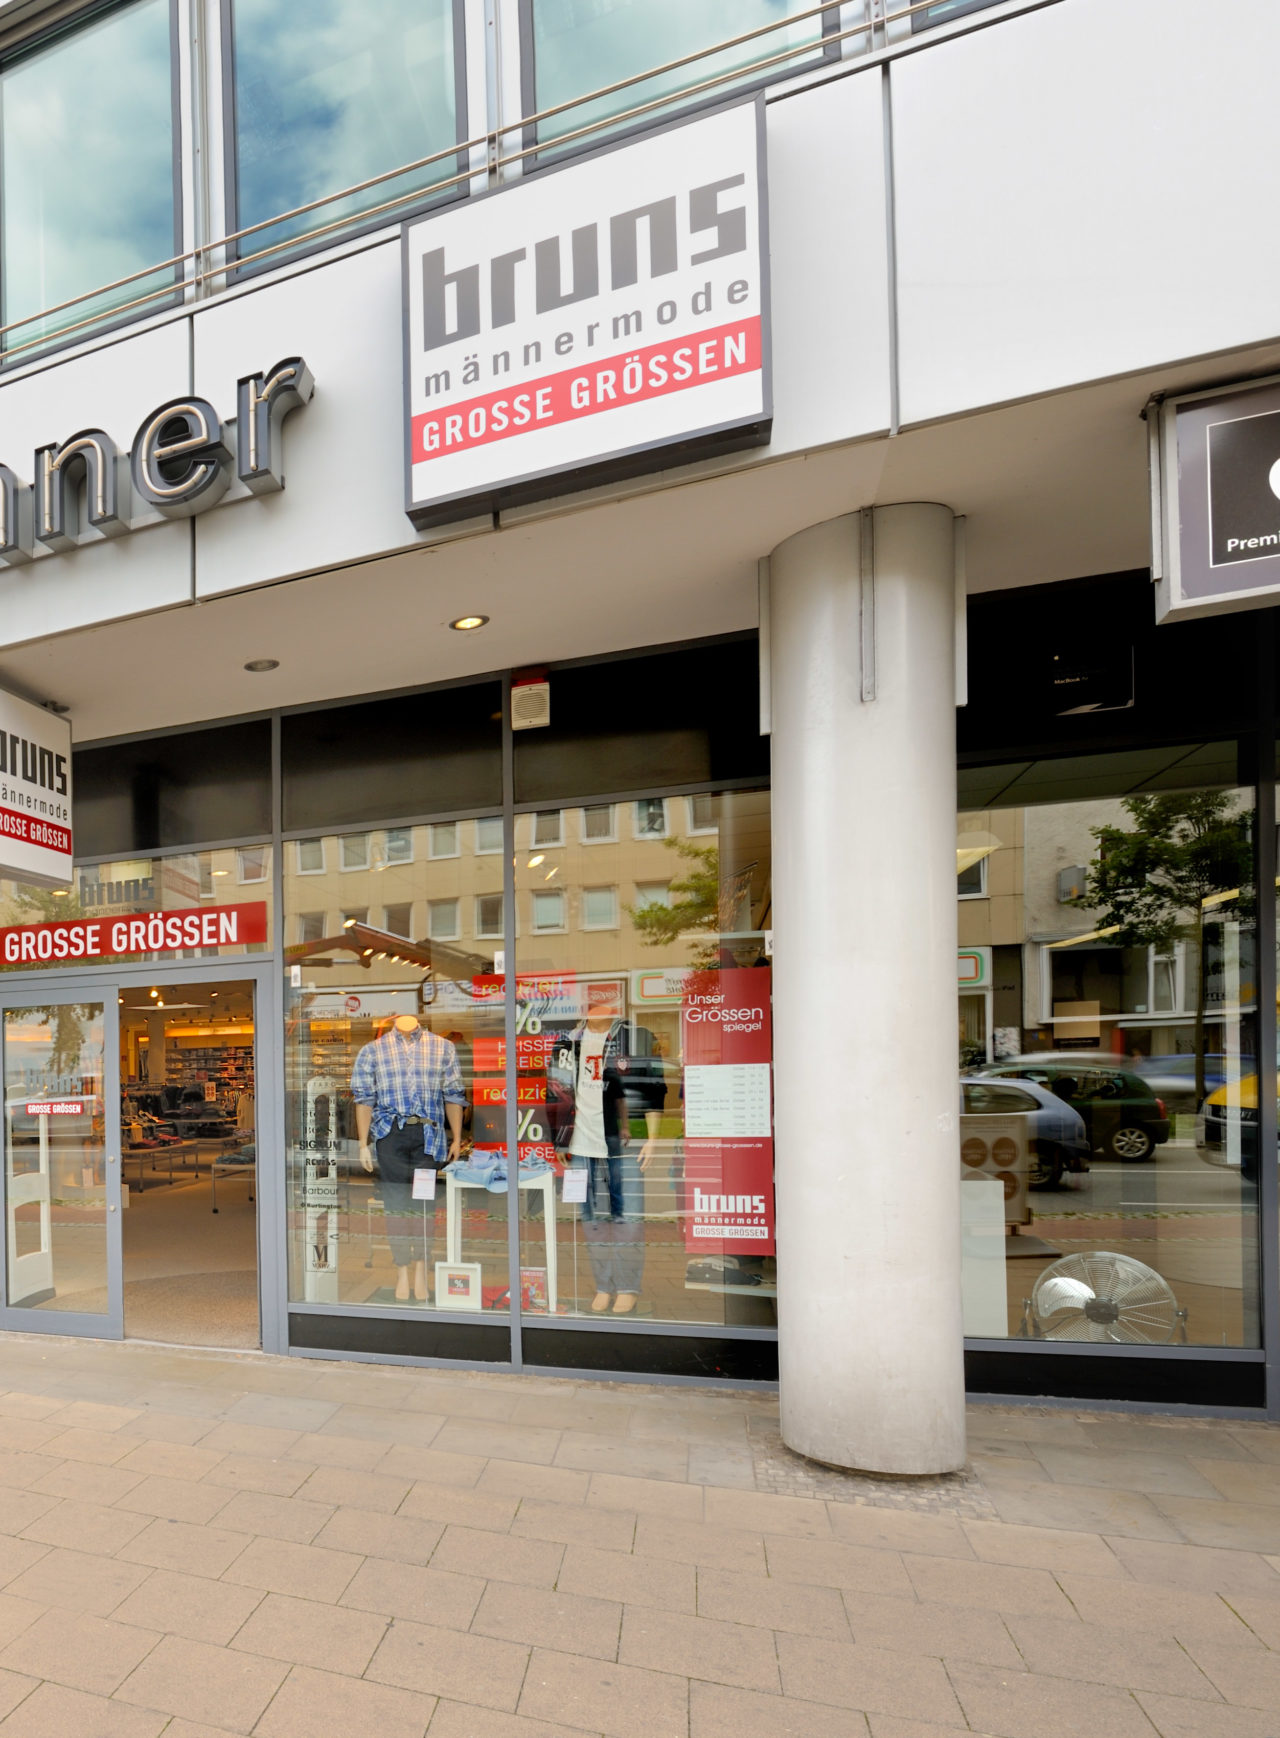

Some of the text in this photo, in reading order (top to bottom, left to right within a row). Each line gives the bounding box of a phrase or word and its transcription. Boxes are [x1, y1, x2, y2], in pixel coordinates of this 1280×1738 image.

[422, 172, 747, 352] bruns
[425, 279, 749, 397] männermode
[422, 331, 746, 452] GROSSE GRÖSSEN
[30, 821, 68, 850] GRÖSSEN
[4, 911, 238, 962] GROSSE GRÖSSEN
[688, 994, 725, 1004] Unser
[685, 1006, 763, 1022] Grössen
[723, 1022, 762, 1033] spiegel
[498, 1040, 554, 1052] HISSE
[28, 1102, 82, 1114] GROSSE GRÖSSEN
[299, 1140, 342, 1151] SIGNUM
[303, 1186, 339, 1195] Barbour
[694, 1188, 766, 1213] bruns
[695, 1227, 726, 1236] GROSSE
[313, 1245, 328, 1262] M
